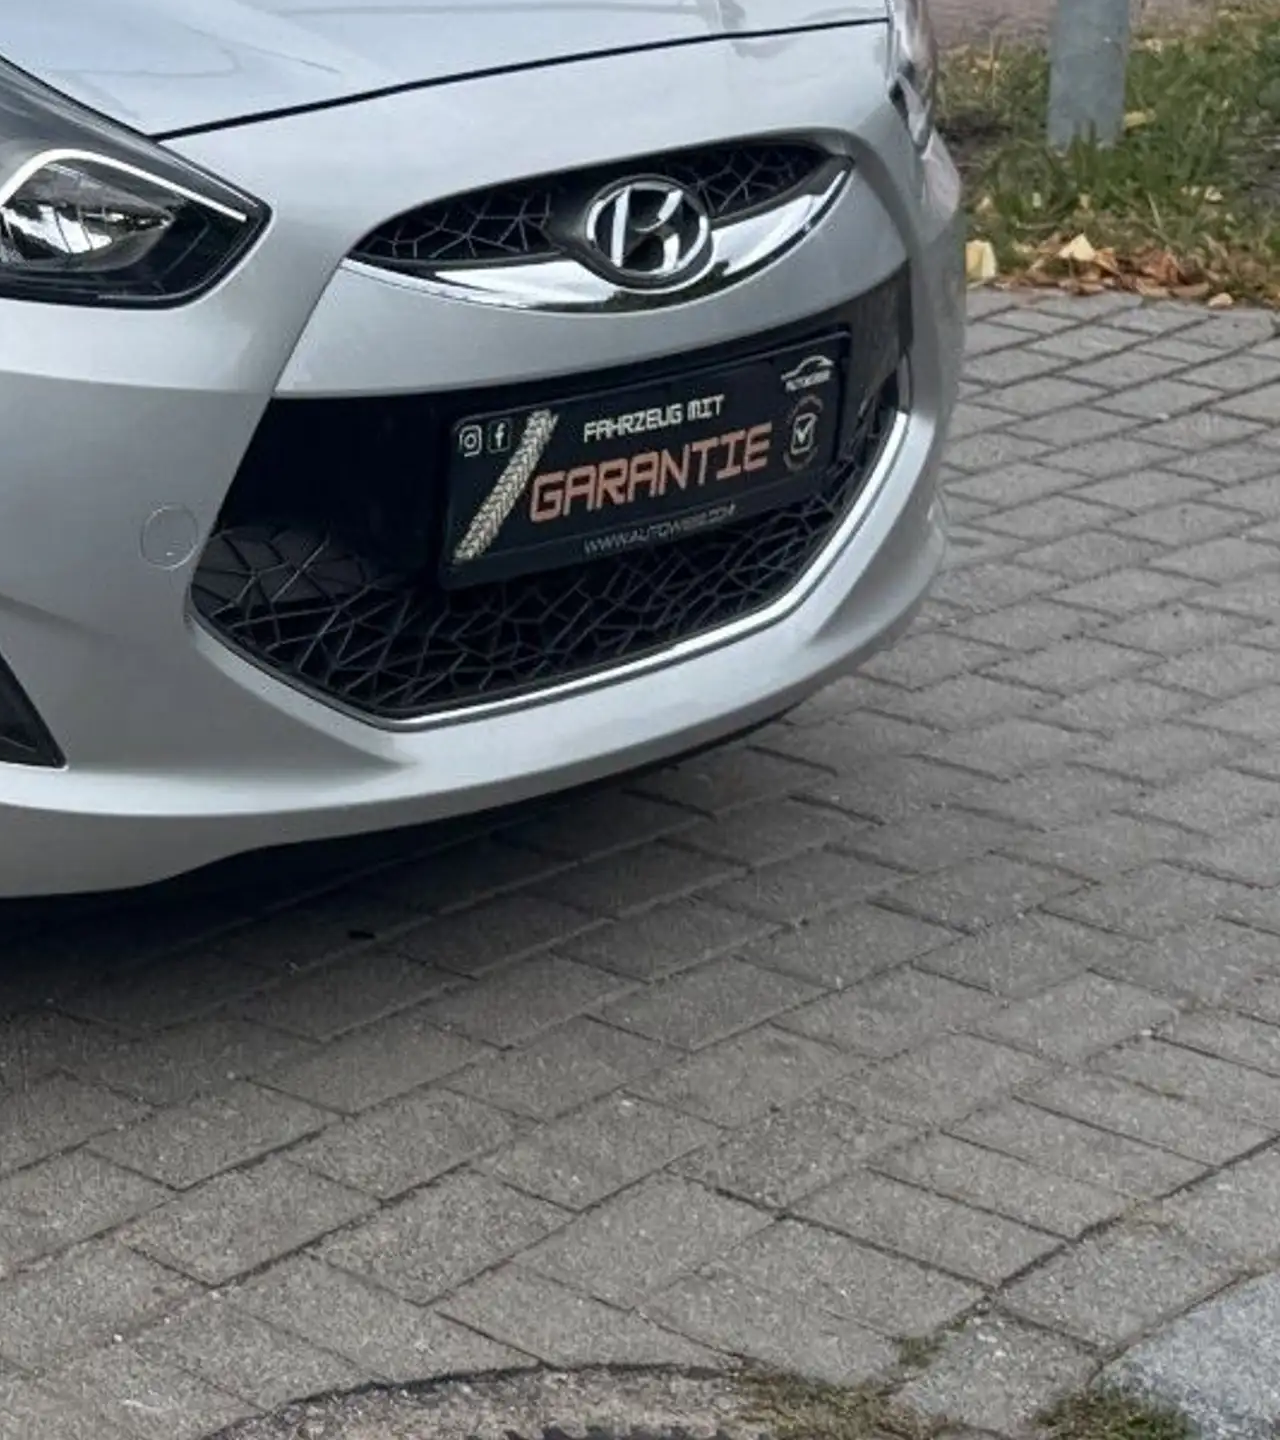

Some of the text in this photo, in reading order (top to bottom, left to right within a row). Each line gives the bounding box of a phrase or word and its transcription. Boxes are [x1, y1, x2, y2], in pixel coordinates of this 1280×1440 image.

[583, 394, 726, 444] FAHRZEUG MIT
[530, 421, 773, 524] GARANTIE
